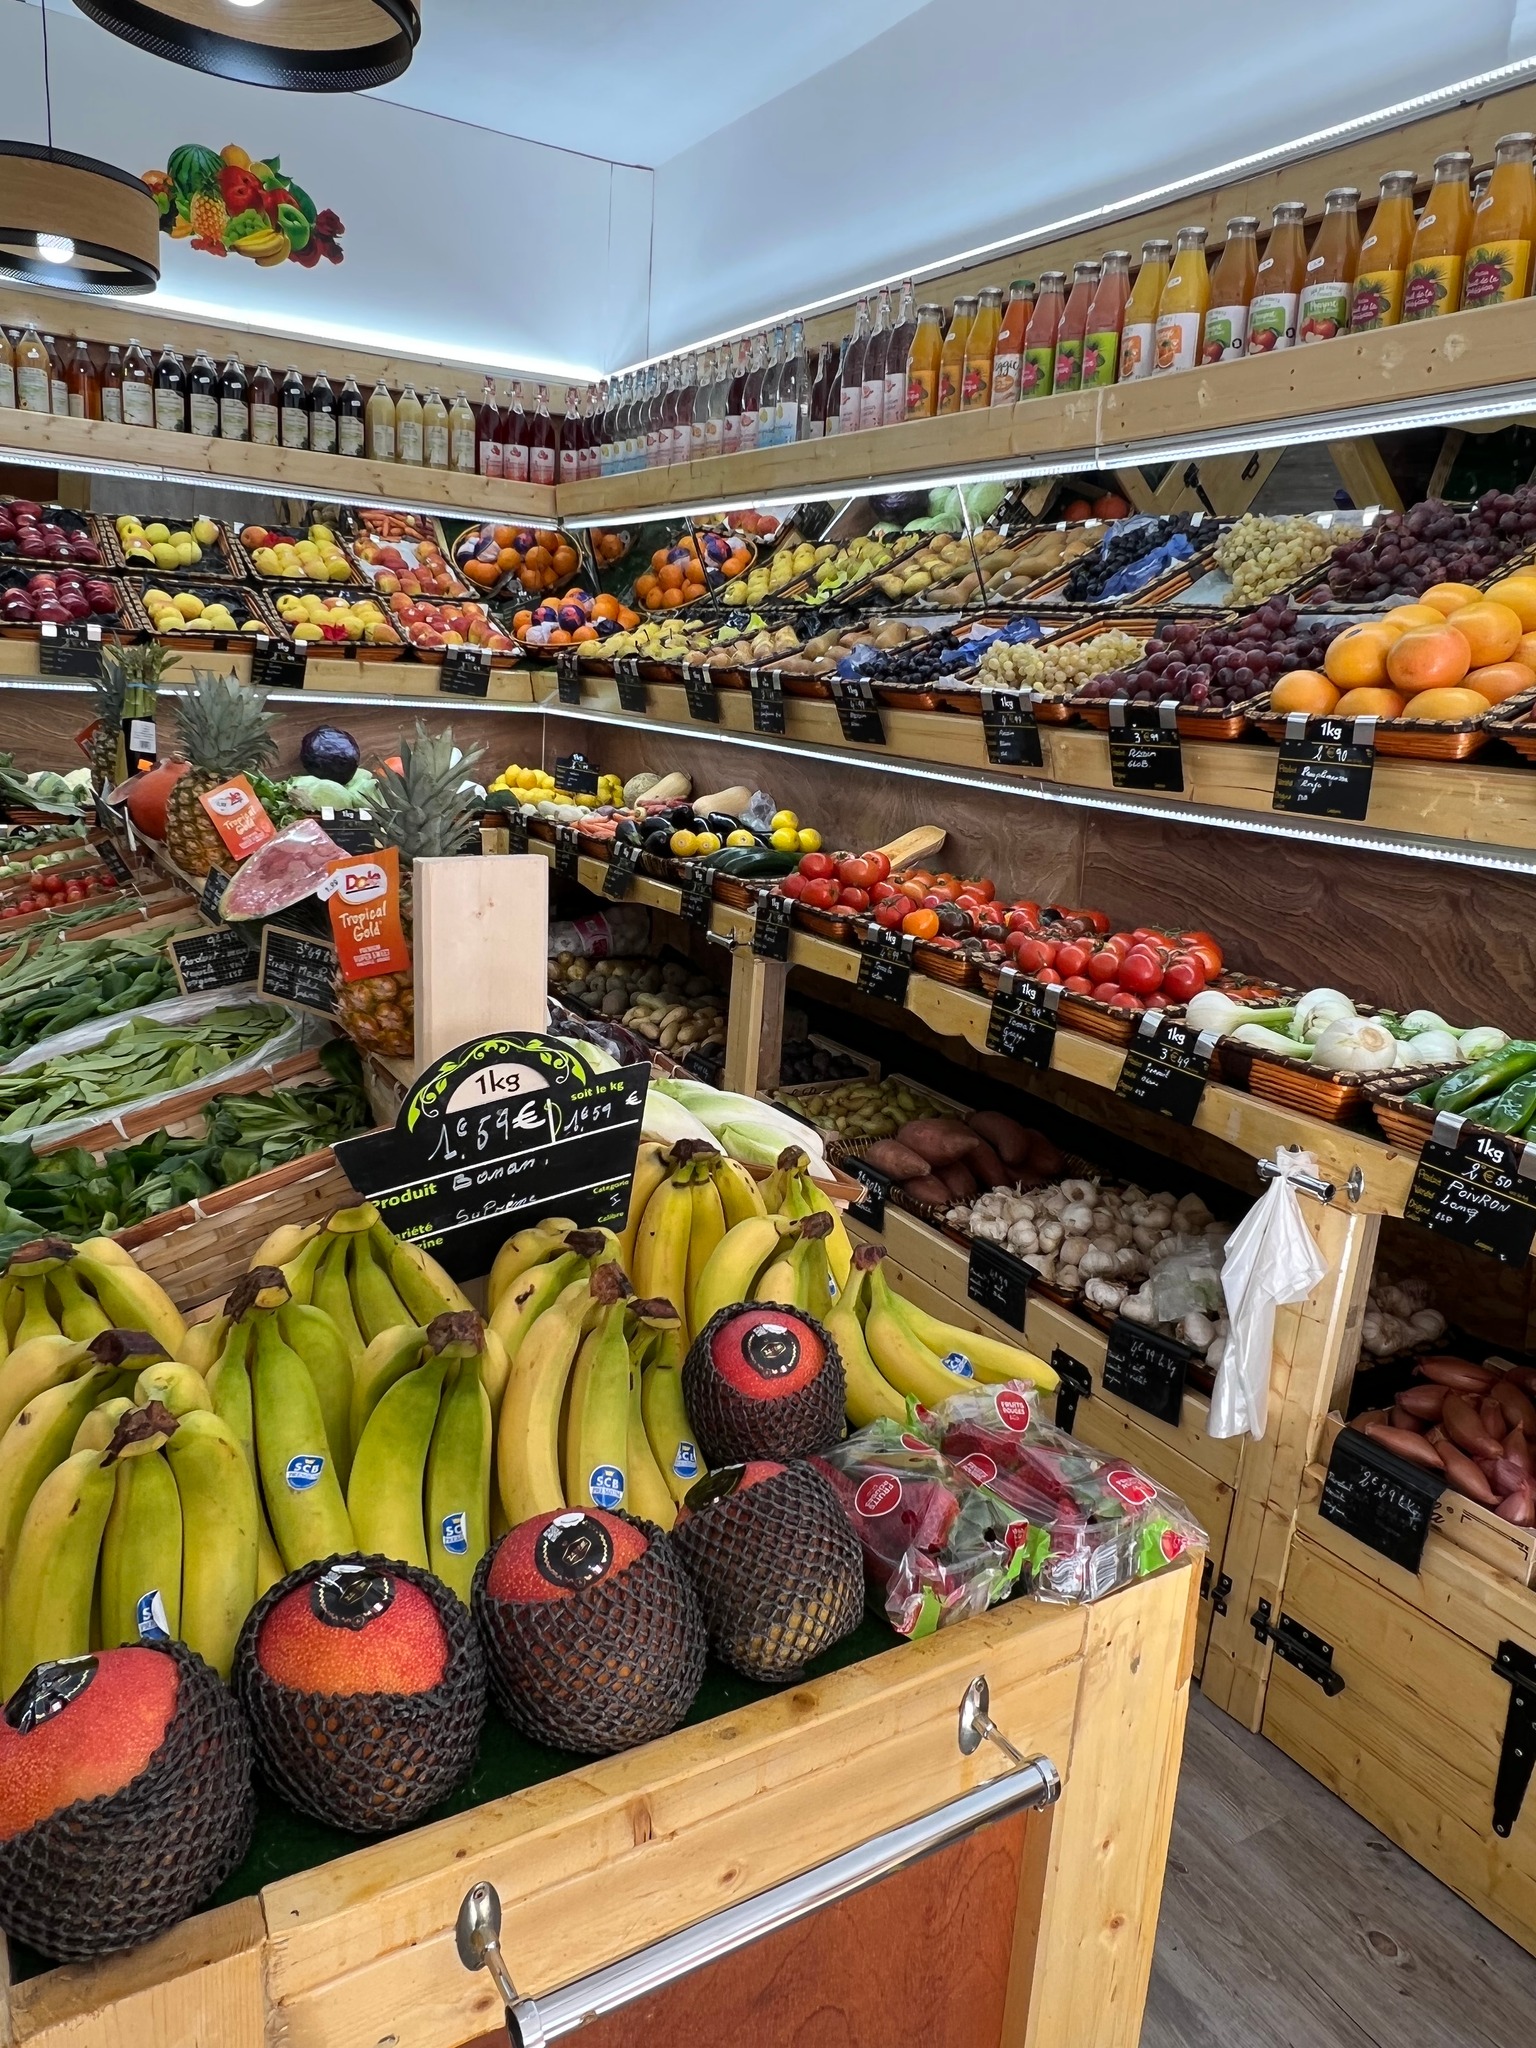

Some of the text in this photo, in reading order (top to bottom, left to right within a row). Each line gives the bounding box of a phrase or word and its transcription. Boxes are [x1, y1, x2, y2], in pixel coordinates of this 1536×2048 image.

[1000, 695, 1014, 710] 1kg
[1320, 721, 1342, 740] 1kg
[345, 870, 382, 891] Dole
[339, 900, 387, 930] Tropical
[353, 922, 381, 942] Gold
[1021, 983, 1037, 1000] 1kg
[1167, 1027, 1186, 1045] 1kg
[475, 1070, 520, 1095] 1kg
[570, 1080, 625, 1102] soit le kg
[1477, 1138, 1504, 1163] 1kg
[394, 1222, 433, 1239] riété
[1000, 1401, 1025, 1409] FRUITS
[294, 1462, 320, 1473] SCB
[596, 1475, 619, 1489] SCB
[869, 1483, 894, 1510] FRUITS
[445, 1524, 462, 1536] SC
